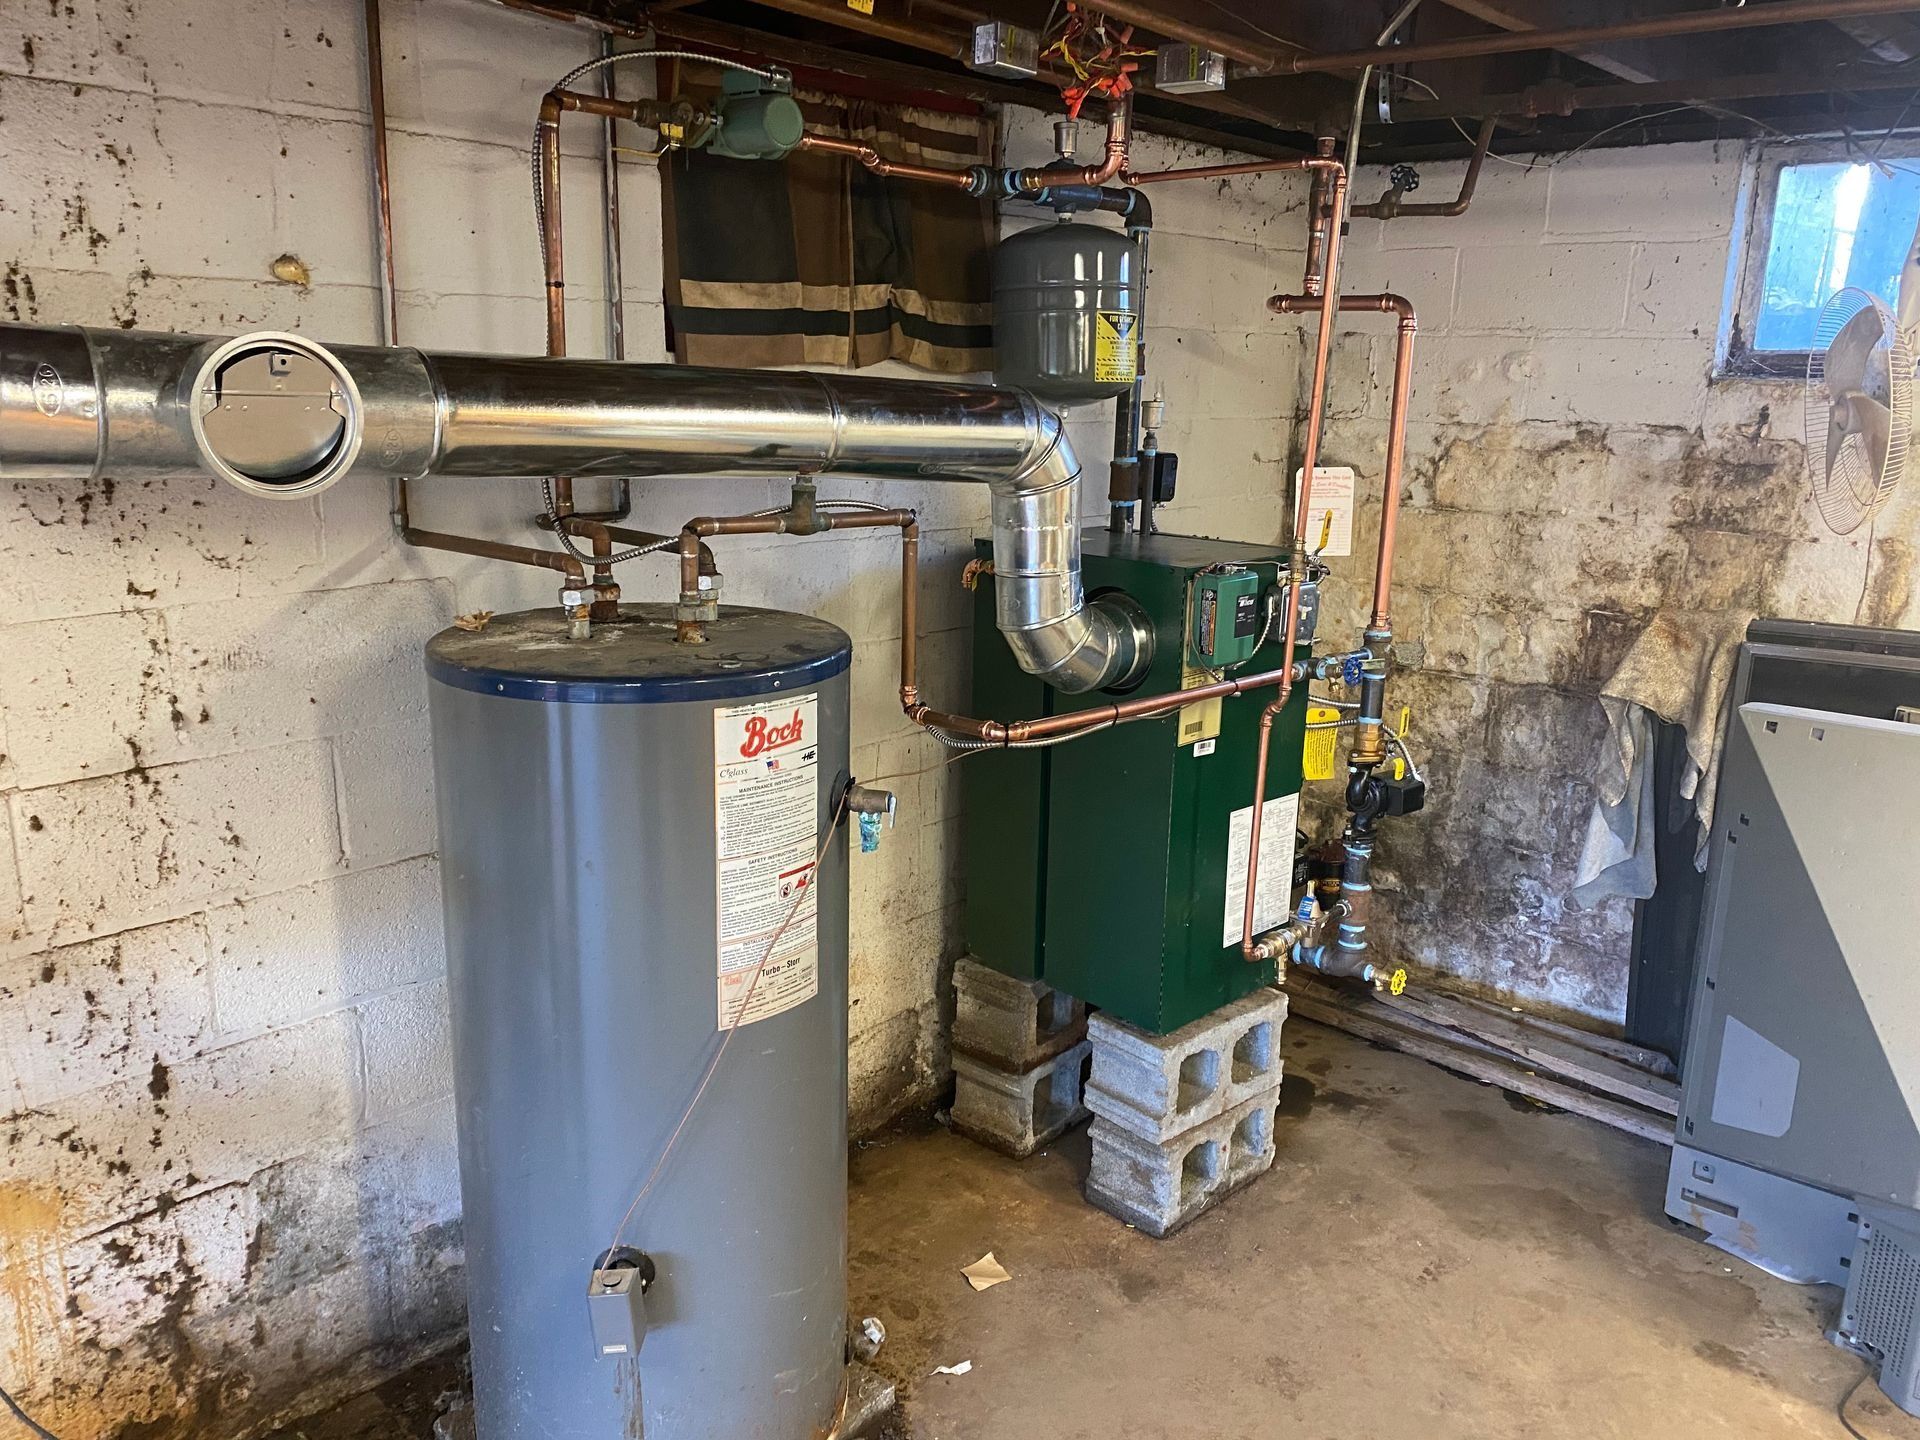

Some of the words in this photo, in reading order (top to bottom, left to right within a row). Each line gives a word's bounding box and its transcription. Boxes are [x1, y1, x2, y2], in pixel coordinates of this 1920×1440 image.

[740, 707, 803, 758] Bock
[739, 783, 773, 793] MAINTENANCE
[774, 775, 804, 787] INSTRUCTIONS
[748, 857, 766, 865] SAFETY
[767, 848, 798, 860] INSTRUCTIONS
[743, 934, 774, 946] INSTALLATION
[762, 965, 780, 977] Turbo
